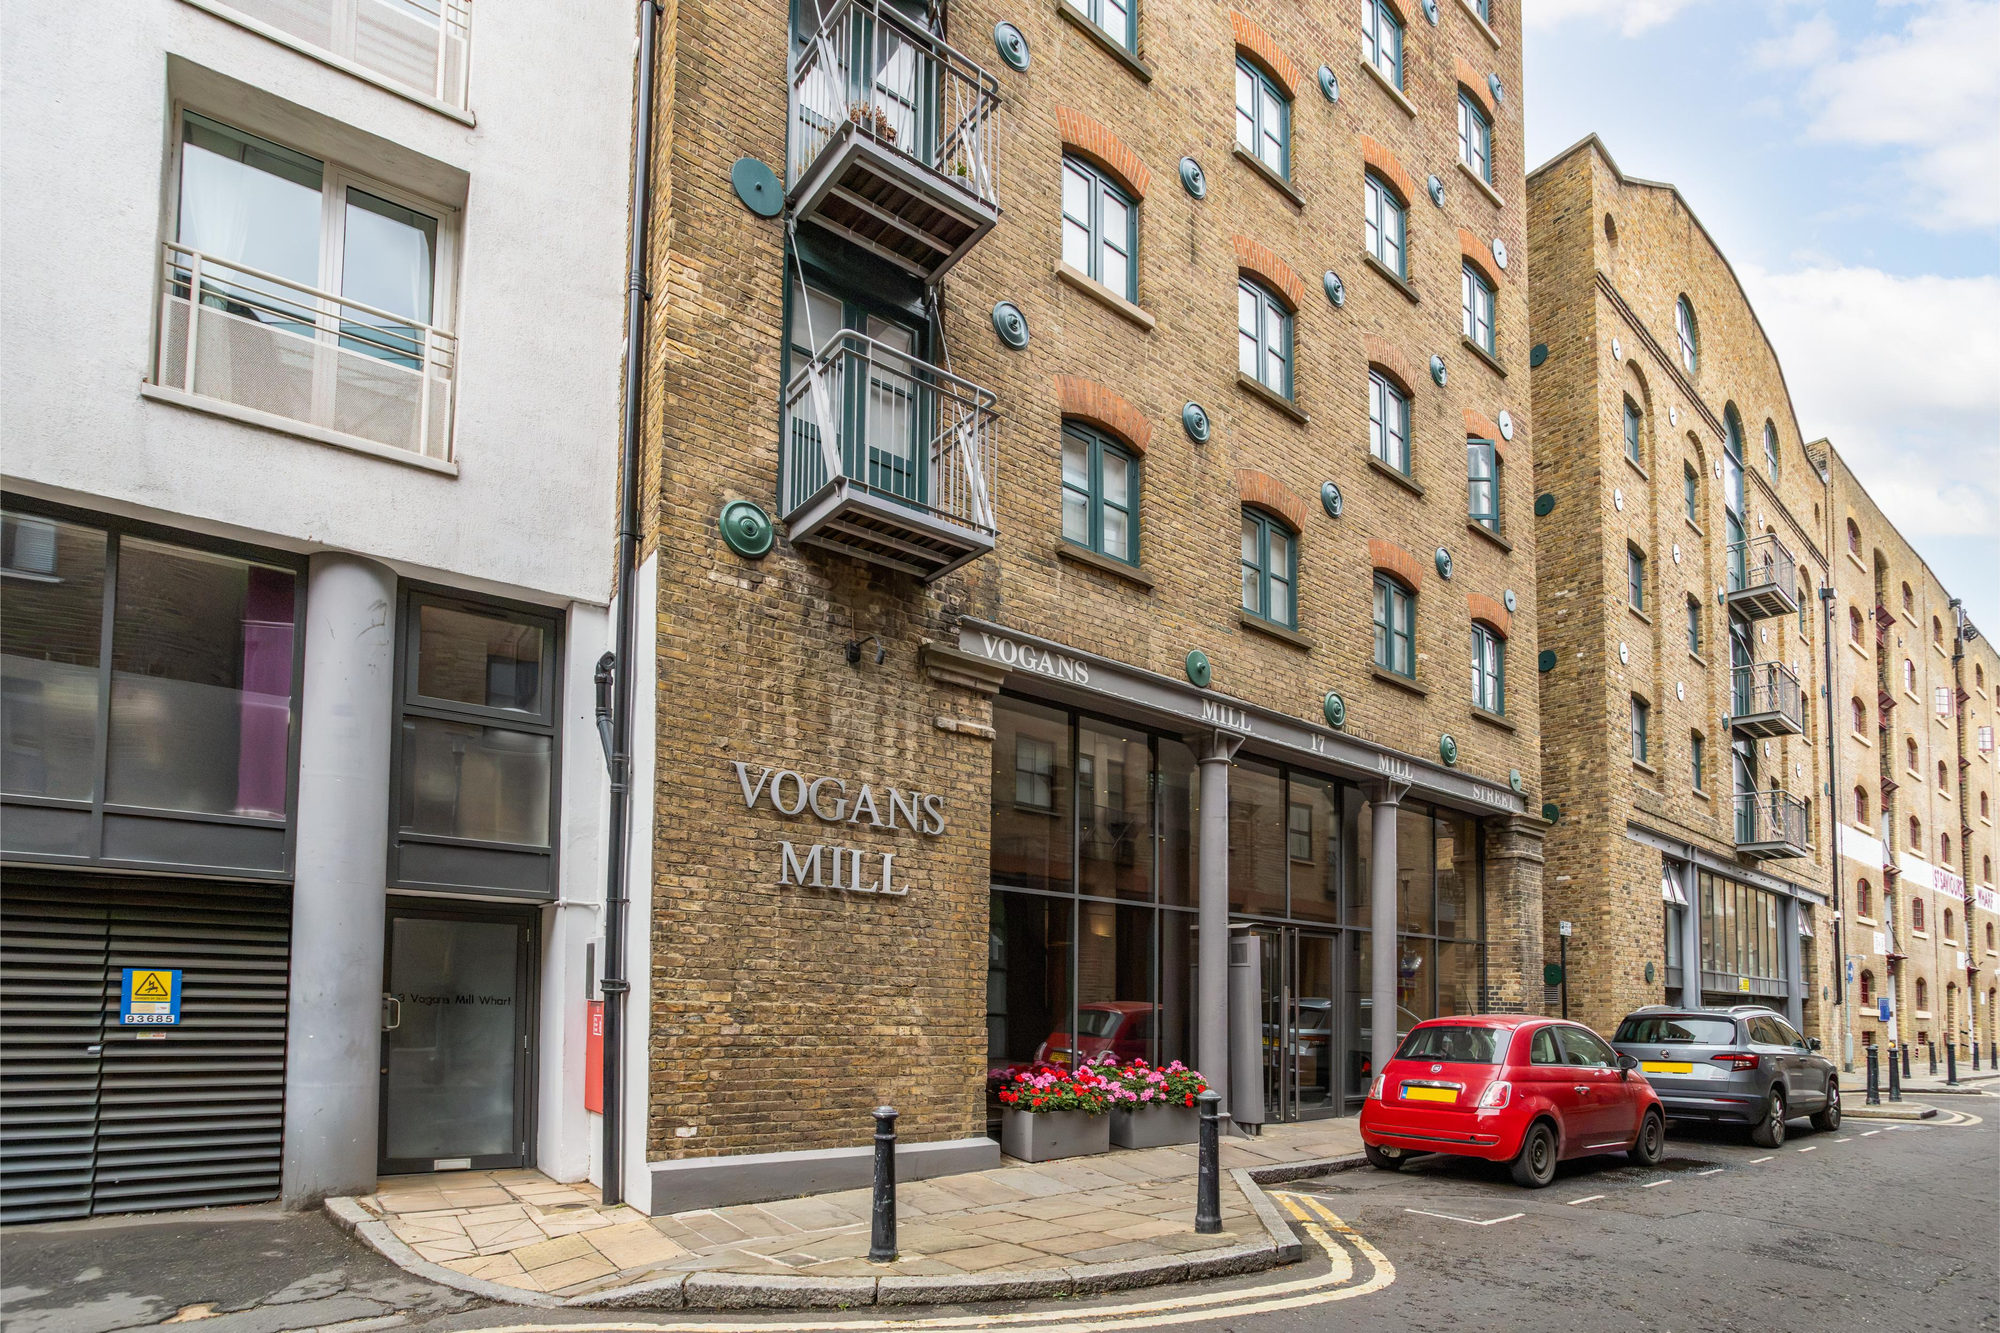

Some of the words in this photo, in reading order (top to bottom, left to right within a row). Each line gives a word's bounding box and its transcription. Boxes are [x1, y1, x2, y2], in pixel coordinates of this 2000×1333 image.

[980, 632, 1089, 684] VOGANS
[1201, 698, 1252, 732] MILL
[1310, 732, 1325, 753] 17
[1378, 753, 1414, 779] MILL
[1472, 783, 1515, 809] STREET
[731, 761, 945, 836] VOGANS
[777, 840, 910, 896] MILL
[126, 1015, 173, 1023] 93685
[455, 995, 474, 1006] Mill
